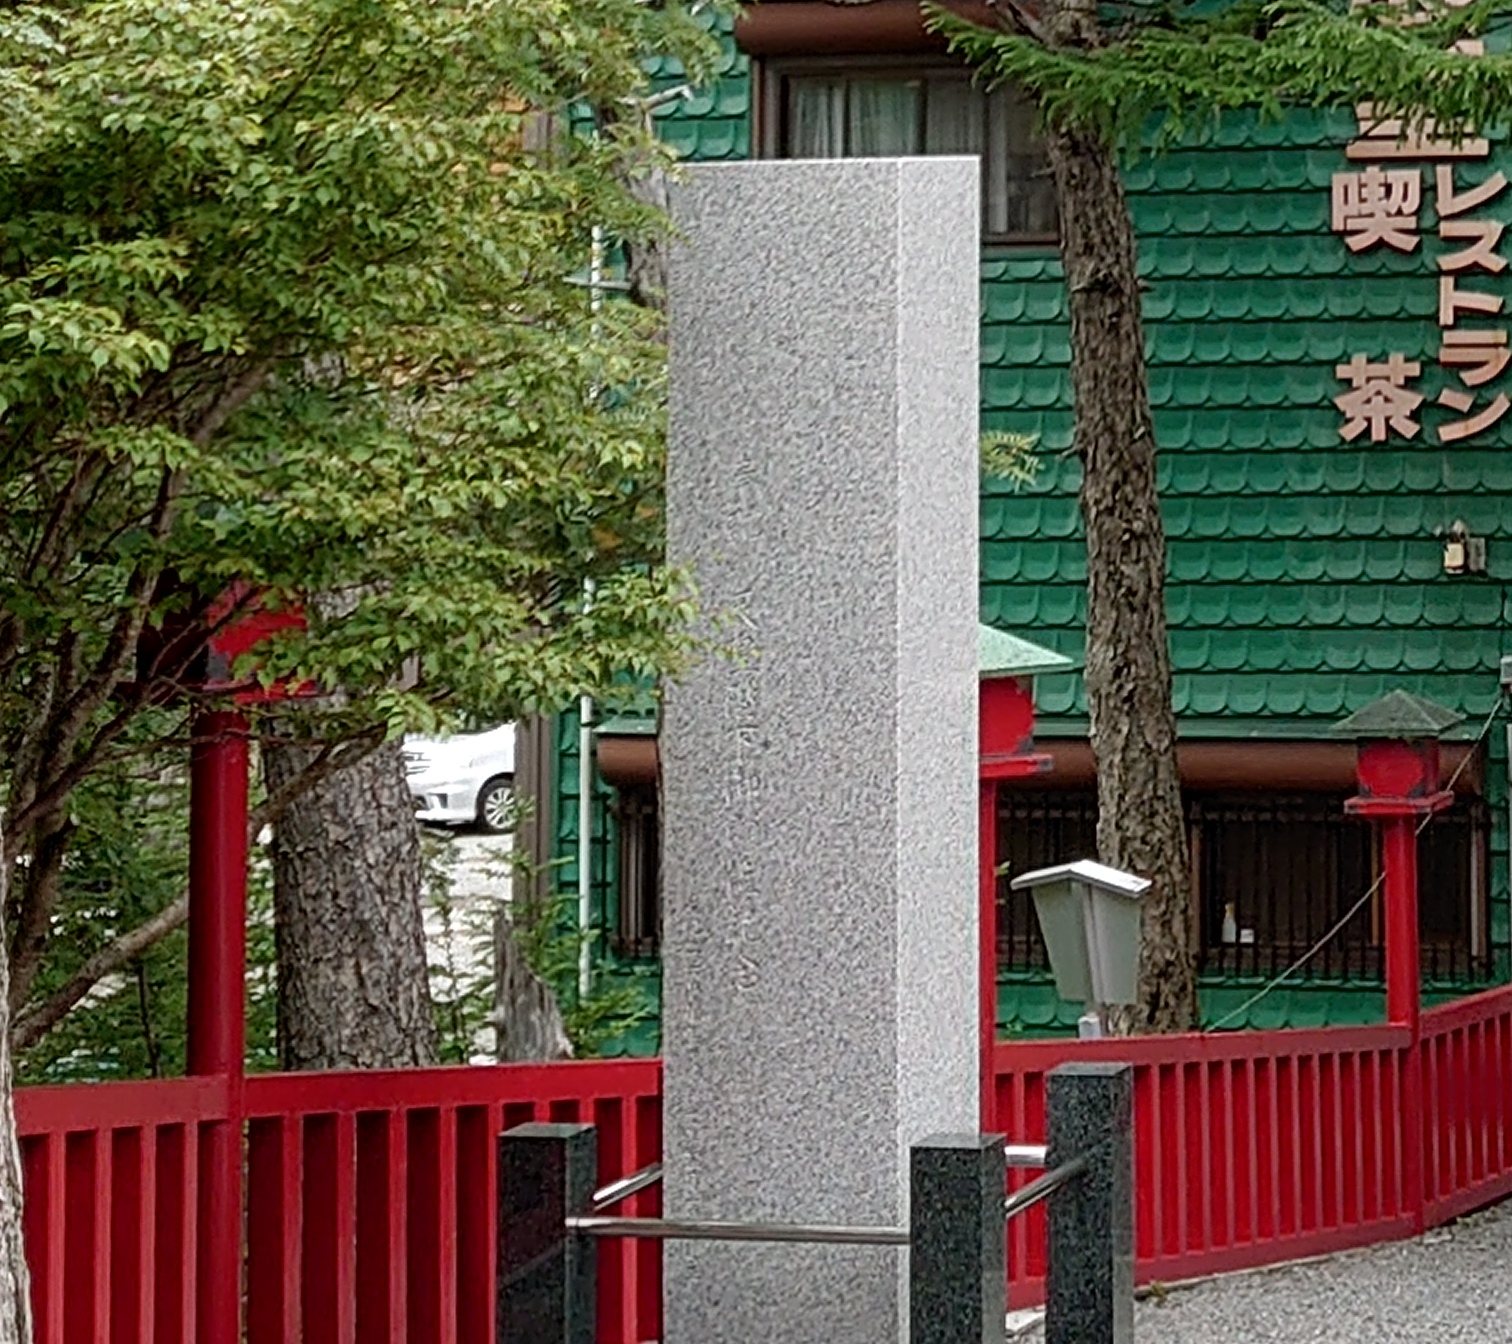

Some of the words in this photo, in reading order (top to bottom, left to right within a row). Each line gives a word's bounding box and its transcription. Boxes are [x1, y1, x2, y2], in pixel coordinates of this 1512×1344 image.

[1331, 165, 1424, 443] 喫茶
[1436, 164, 1511, 443] レストラン
